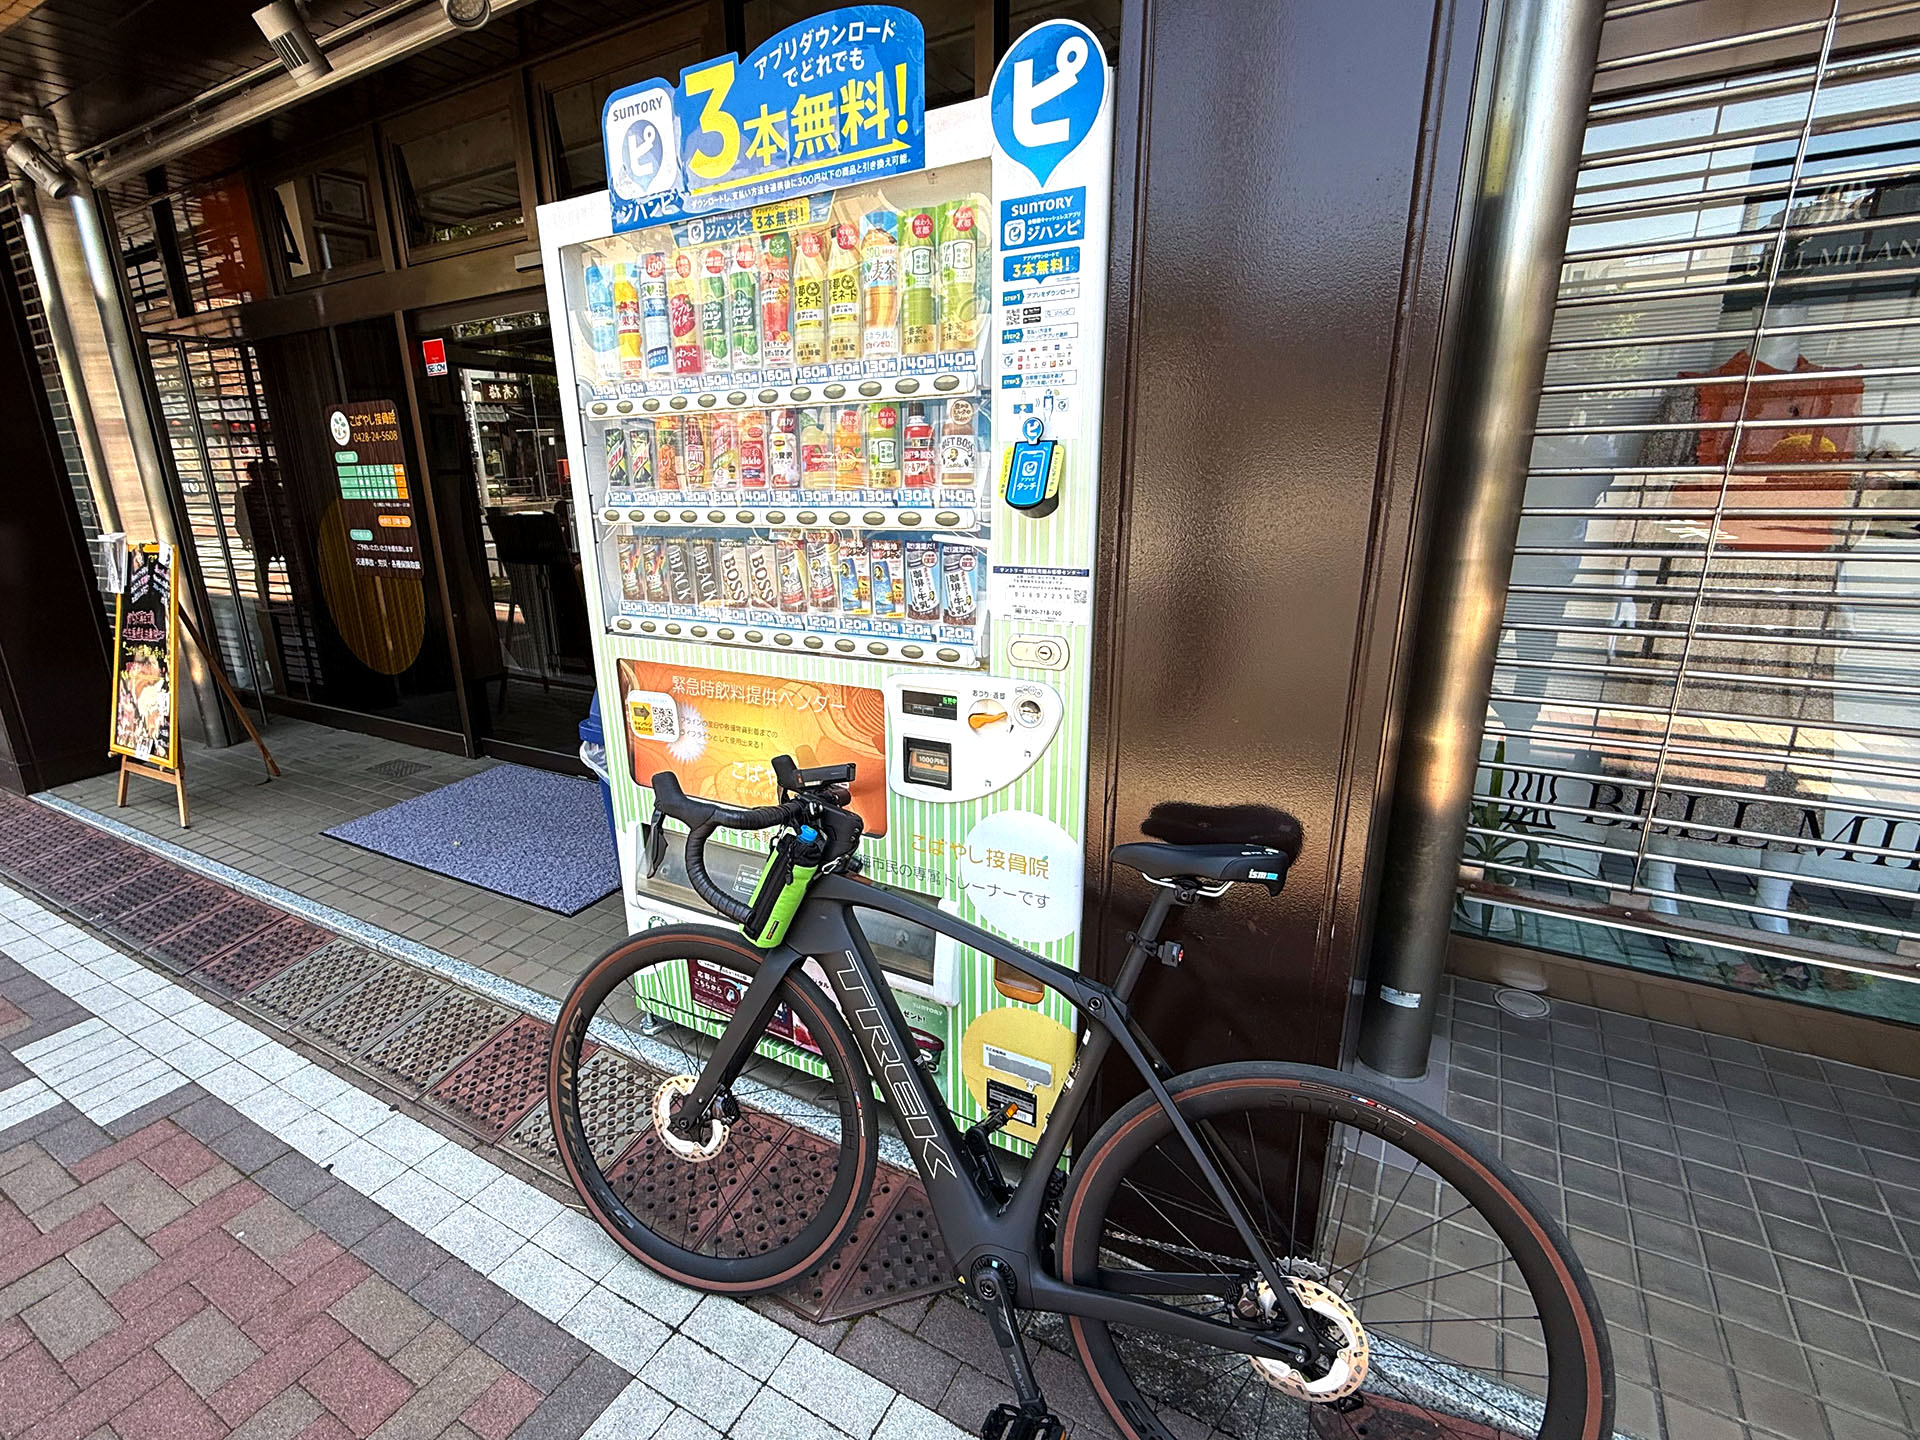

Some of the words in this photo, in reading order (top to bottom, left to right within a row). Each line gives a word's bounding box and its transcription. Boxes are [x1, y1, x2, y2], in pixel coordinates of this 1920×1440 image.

[753, 18, 897, 81] アプリダウンロード
[782, 47, 866, 88] でどれでも
[1012, 36, 1089, 148] ピ
[612, 95, 663, 122] SUNTORY
[684, 60, 909, 180] 3本無料!
[628, 125, 656, 177] ピ
[619, 190, 677, 224] ジハンピ
[756, 208, 805, 229] 3本無料!
[1011, 195, 1074, 217] SUNTORY
[705, 219, 748, 239] ジハンピ
[1027, 219, 1081, 241] ジハンピ
[872, 259, 897, 281] 麦茶
[1012, 256, 1070, 278] 3本無料!
[939, 354, 975, 368] 140円
[348, 411, 397, 427] こばやし接骨院
[353, 430, 398, 443] 0428-24-5608
[1017, 481, 1037, 491] タッチ
[724, 555, 746, 603] BOSS
[751, 553, 775, 603] BOSS
[671, 675, 848, 713] 緊急時飲料提供ベンダー
[1578, 782, 1769, 850] BELL
[911, 833, 1050, 880] こばやし接骨院
[1248, 868, 1268, 880] ism
[693, 979, 724, 995] こちらから
[836, 949, 958, 1180] TREK
